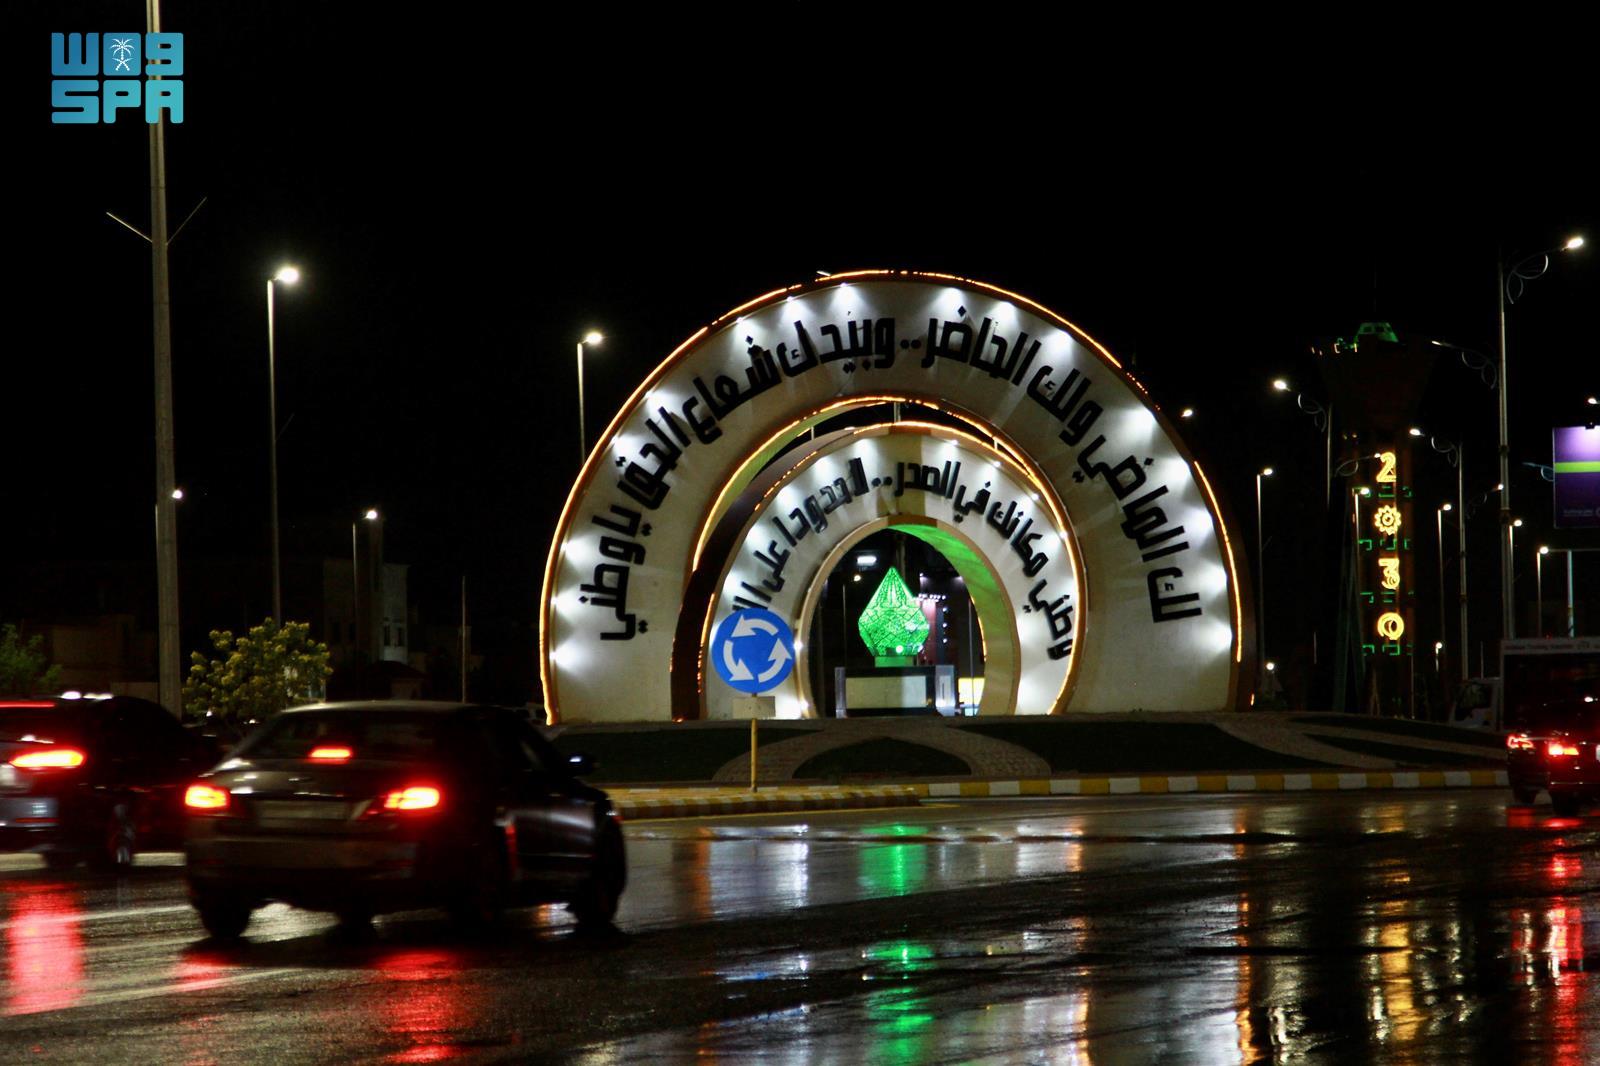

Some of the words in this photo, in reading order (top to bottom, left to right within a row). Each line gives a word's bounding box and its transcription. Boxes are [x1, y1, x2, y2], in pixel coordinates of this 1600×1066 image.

[776, 317, 895, 377] وبيدك
[682, 335, 782, 445] شعاع
[1026, 365, 1103, 447] ولك
[615, 406, 692, 511] الحق
[1072, 434, 1190, 563] الماضي
[954, 481, 991, 523] في
[987, 501, 1049, 577] مكانك
[1023, 579, 1074, 661] وطني
[1148, 566, 1203, 624] لك
